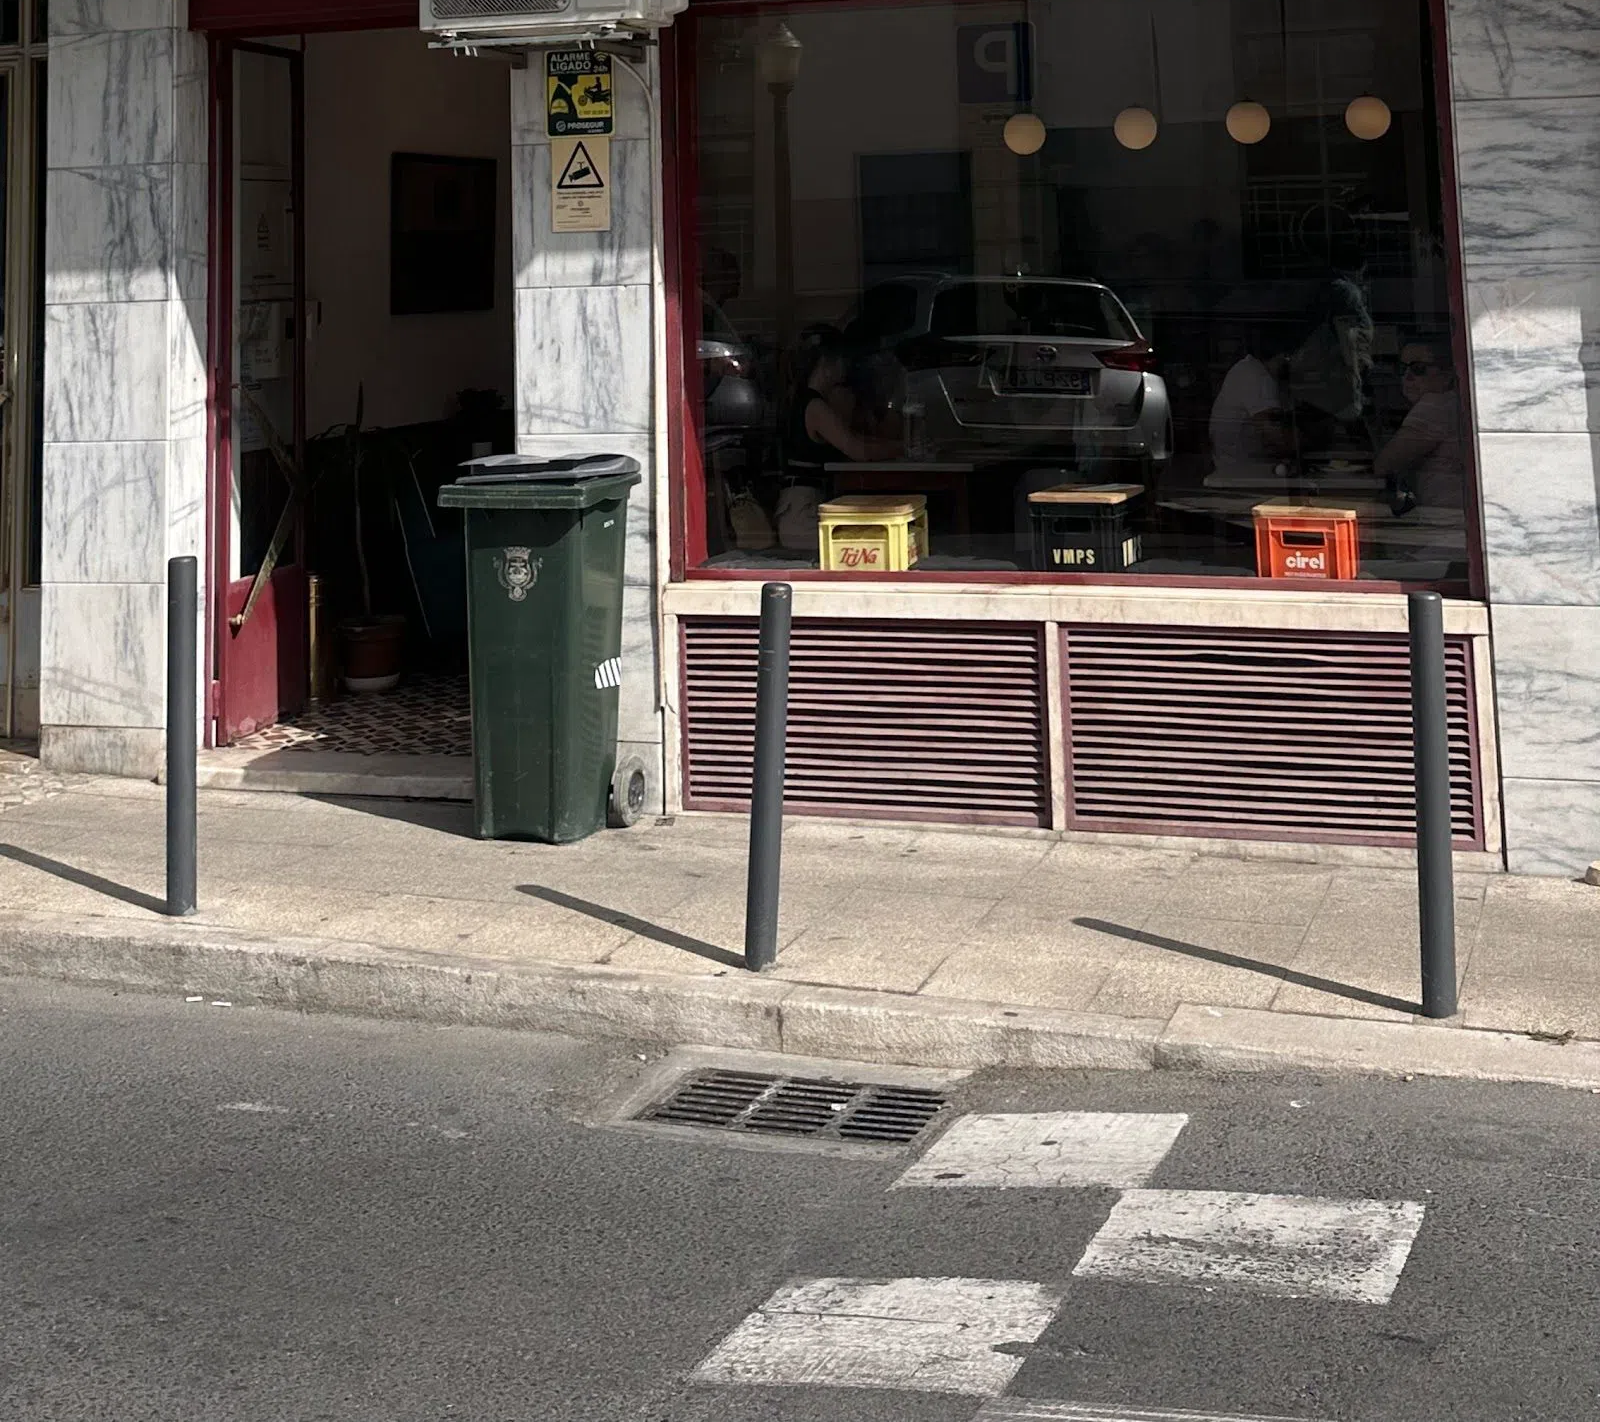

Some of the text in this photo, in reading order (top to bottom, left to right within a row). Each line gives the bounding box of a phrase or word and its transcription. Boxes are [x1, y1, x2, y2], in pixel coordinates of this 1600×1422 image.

[550, 51, 591, 63] ALARME
[550, 61, 592, 72] LIGADO
[567, 121, 605, 130] PROSEGUR
[1052, 548, 1096, 565] VMPS
[1285, 550, 1325, 570] cirel
